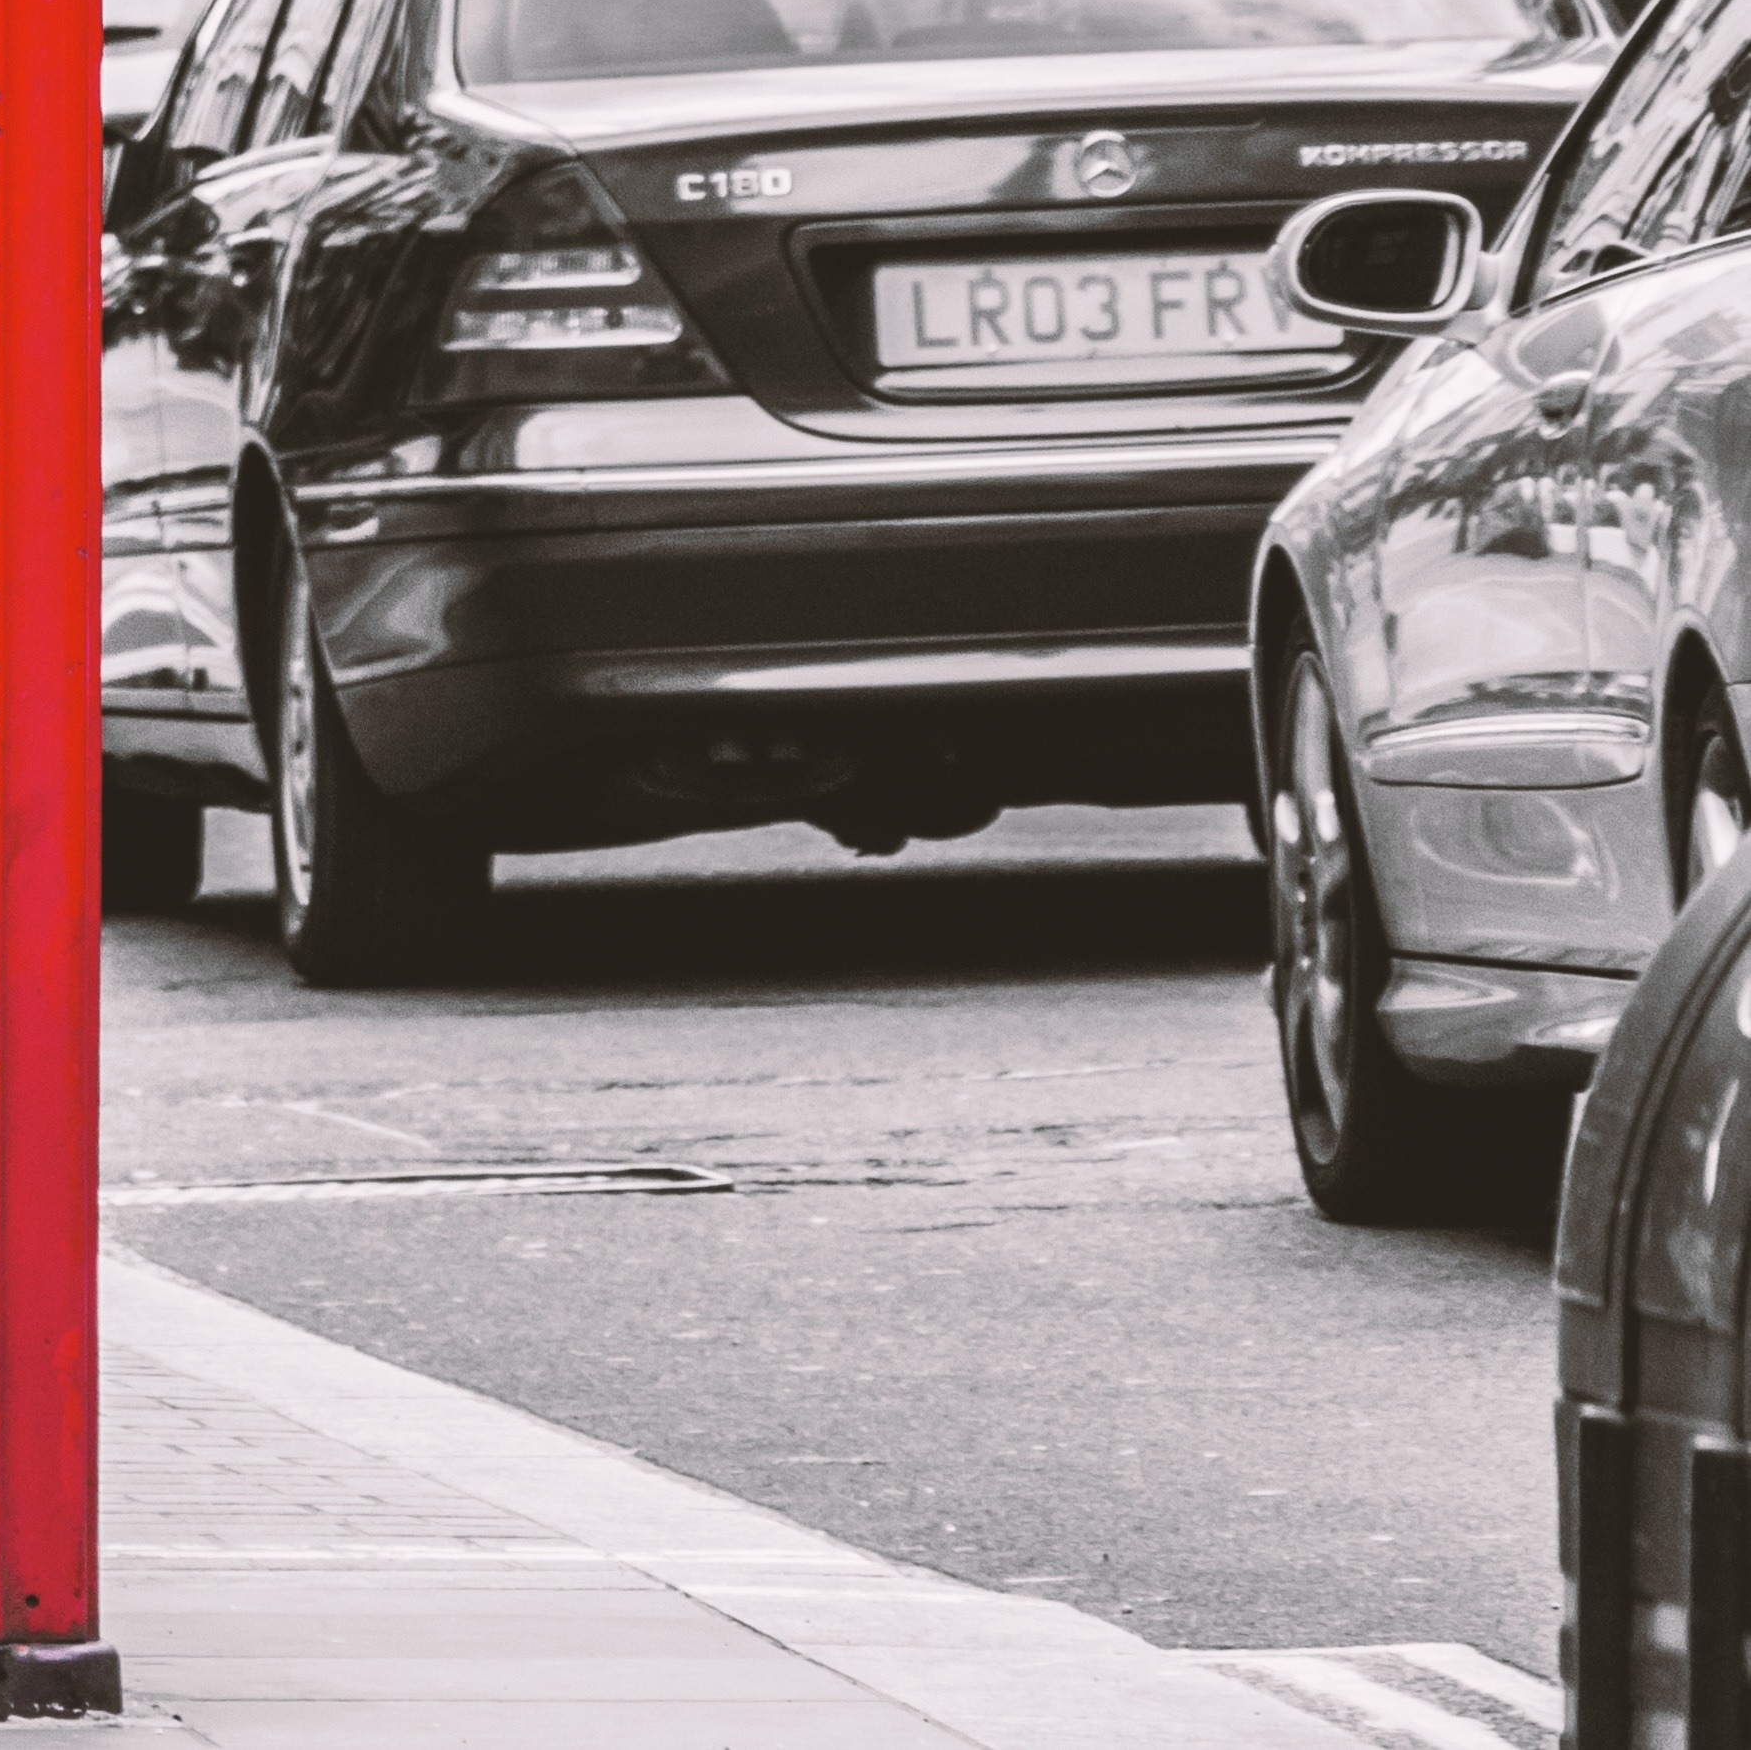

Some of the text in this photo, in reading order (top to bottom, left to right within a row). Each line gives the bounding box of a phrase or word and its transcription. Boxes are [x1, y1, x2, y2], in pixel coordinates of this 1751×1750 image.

[1299, 140, 1529, 167] KOMPRESSOR
[676, 169, 792, 201] C180
[911, 268, 1121, 348] LR03
